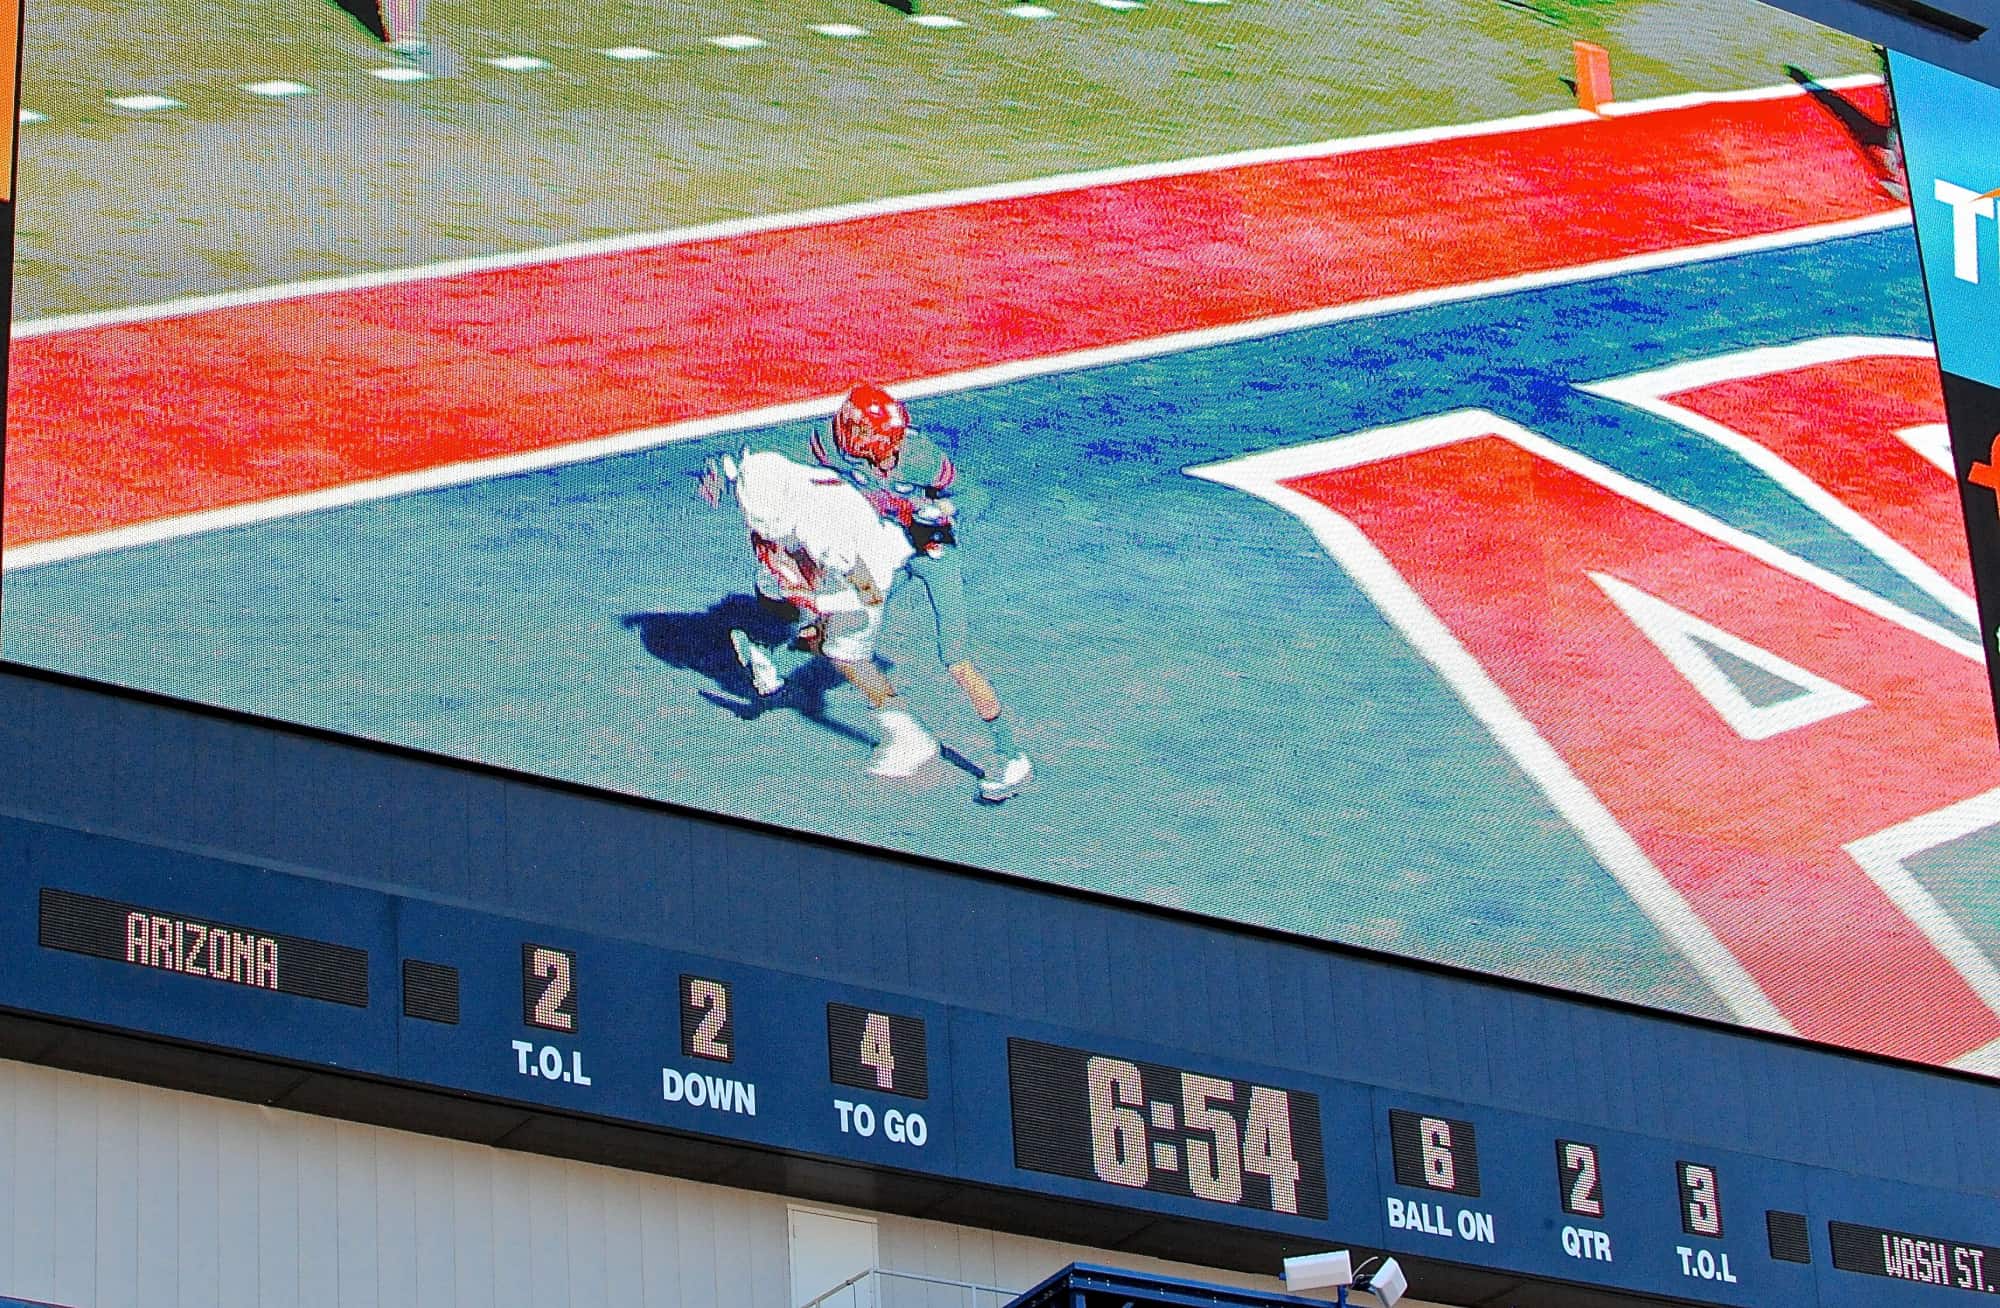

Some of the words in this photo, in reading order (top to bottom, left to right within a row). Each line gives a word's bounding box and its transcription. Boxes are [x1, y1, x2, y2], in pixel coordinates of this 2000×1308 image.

[126, 911, 279, 990] ARIZONA
[532, 948, 572, 1028] 2
[690, 979, 728, 1058] 2
[511, 1039, 592, 1086] T.O.L
[860, 1013, 895, 1088] 4
[662, 1068, 756, 1116] DOWN
[834, 1100, 876, 1137] TO
[883, 1112, 928, 1147] GO
[1087, 1055, 1300, 1215] 6:54
[1420, 1116, 1455, 1190] 6
[1565, 1143, 1600, 1214] 2
[1685, 1164, 1719, 1235] 3
[1387, 1197, 1453, 1237] BALL
[1458, 1212, 1495, 1244] ON
[1562, 1227, 1612, 1262] QTR
[1676, 1246, 1737, 1283] T.O.L
[1882, 1234, 1949, 1285] WASH
[1956, 1248, 1995, 1293] ST.
